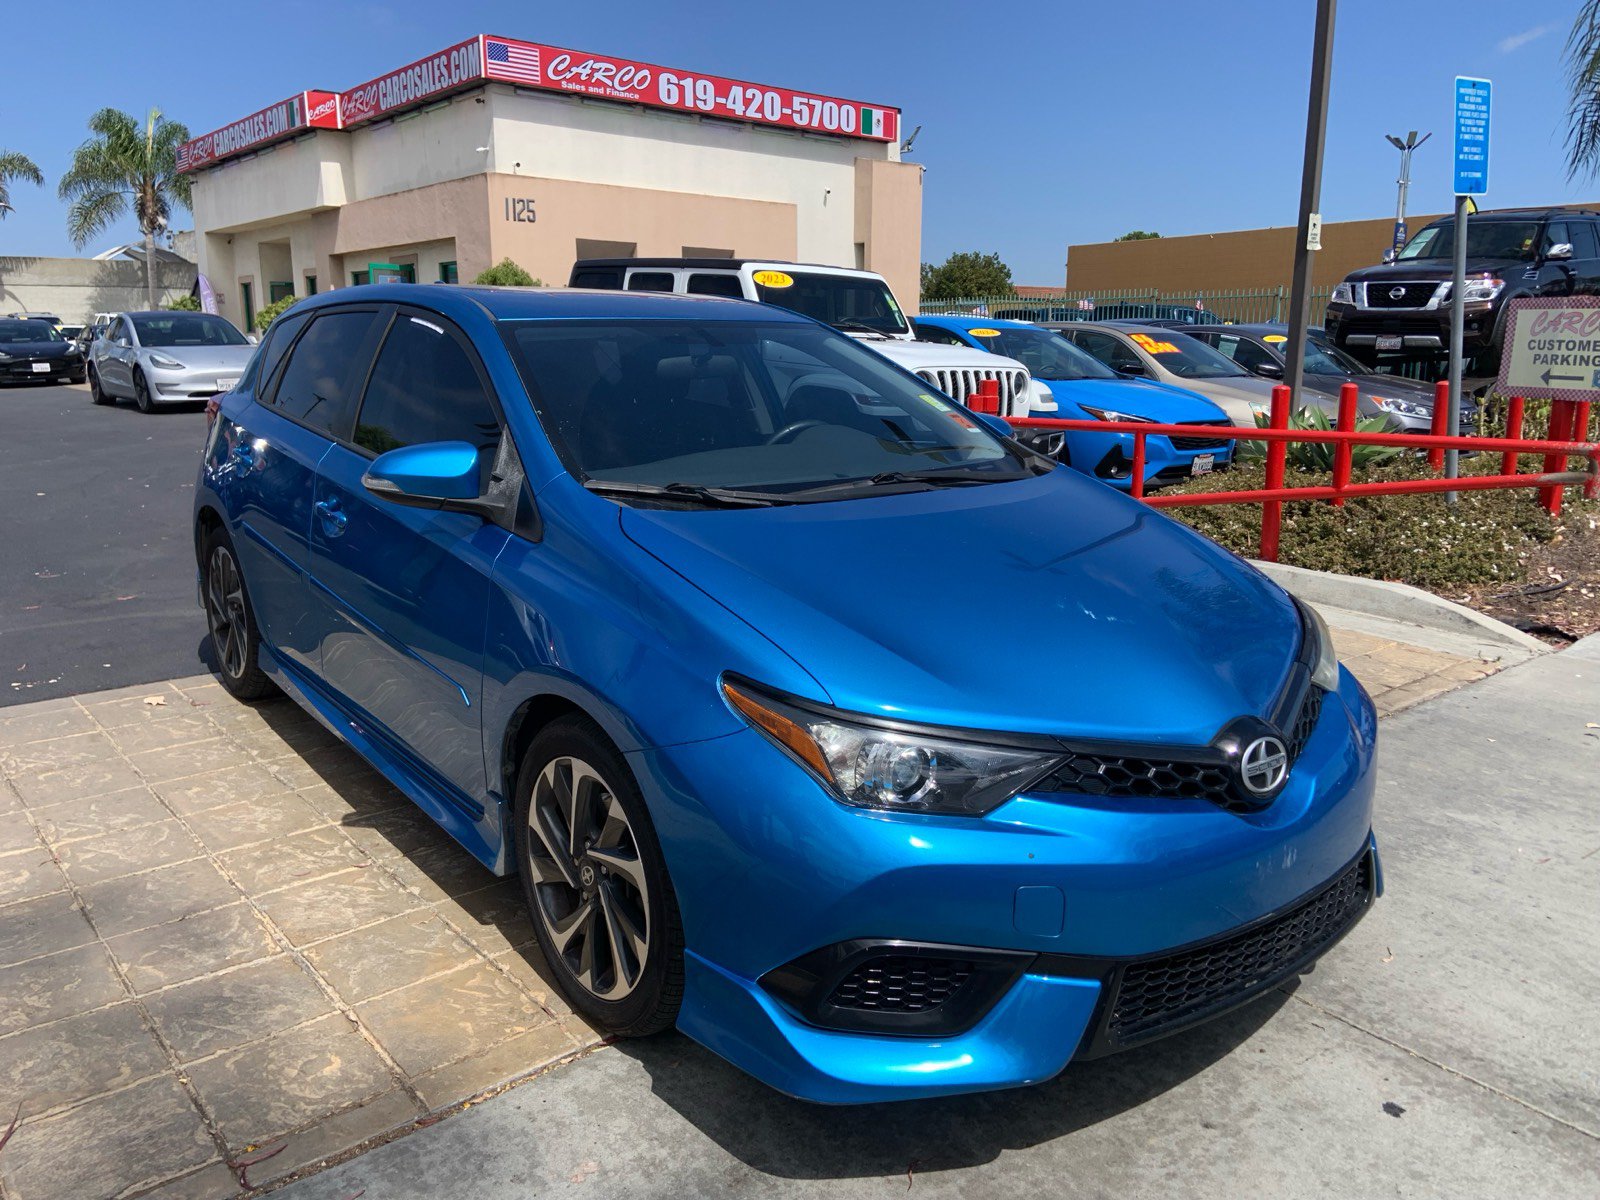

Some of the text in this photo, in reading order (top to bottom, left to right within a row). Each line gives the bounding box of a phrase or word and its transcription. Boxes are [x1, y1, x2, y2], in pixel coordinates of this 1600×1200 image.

[340, 42, 480, 121] CARCO CARCOSALES.COM
[546, 54, 651, 92] CARCO
[561, 81, 640, 100] Sales and Finance
[658, 72, 856, 133] 619-420-5700
[308, 99, 336, 121] CARCO
[188, 103, 288, 164] CARCO CARCOSALES.COM
[505, 197, 537, 223] 1125
[761, 273, 786, 284] 2023
[1530, 310, 1600, 338] CARC
[1527, 339, 1600, 352] CUSTOME
[1532, 353, 1600, 367] PARKING
